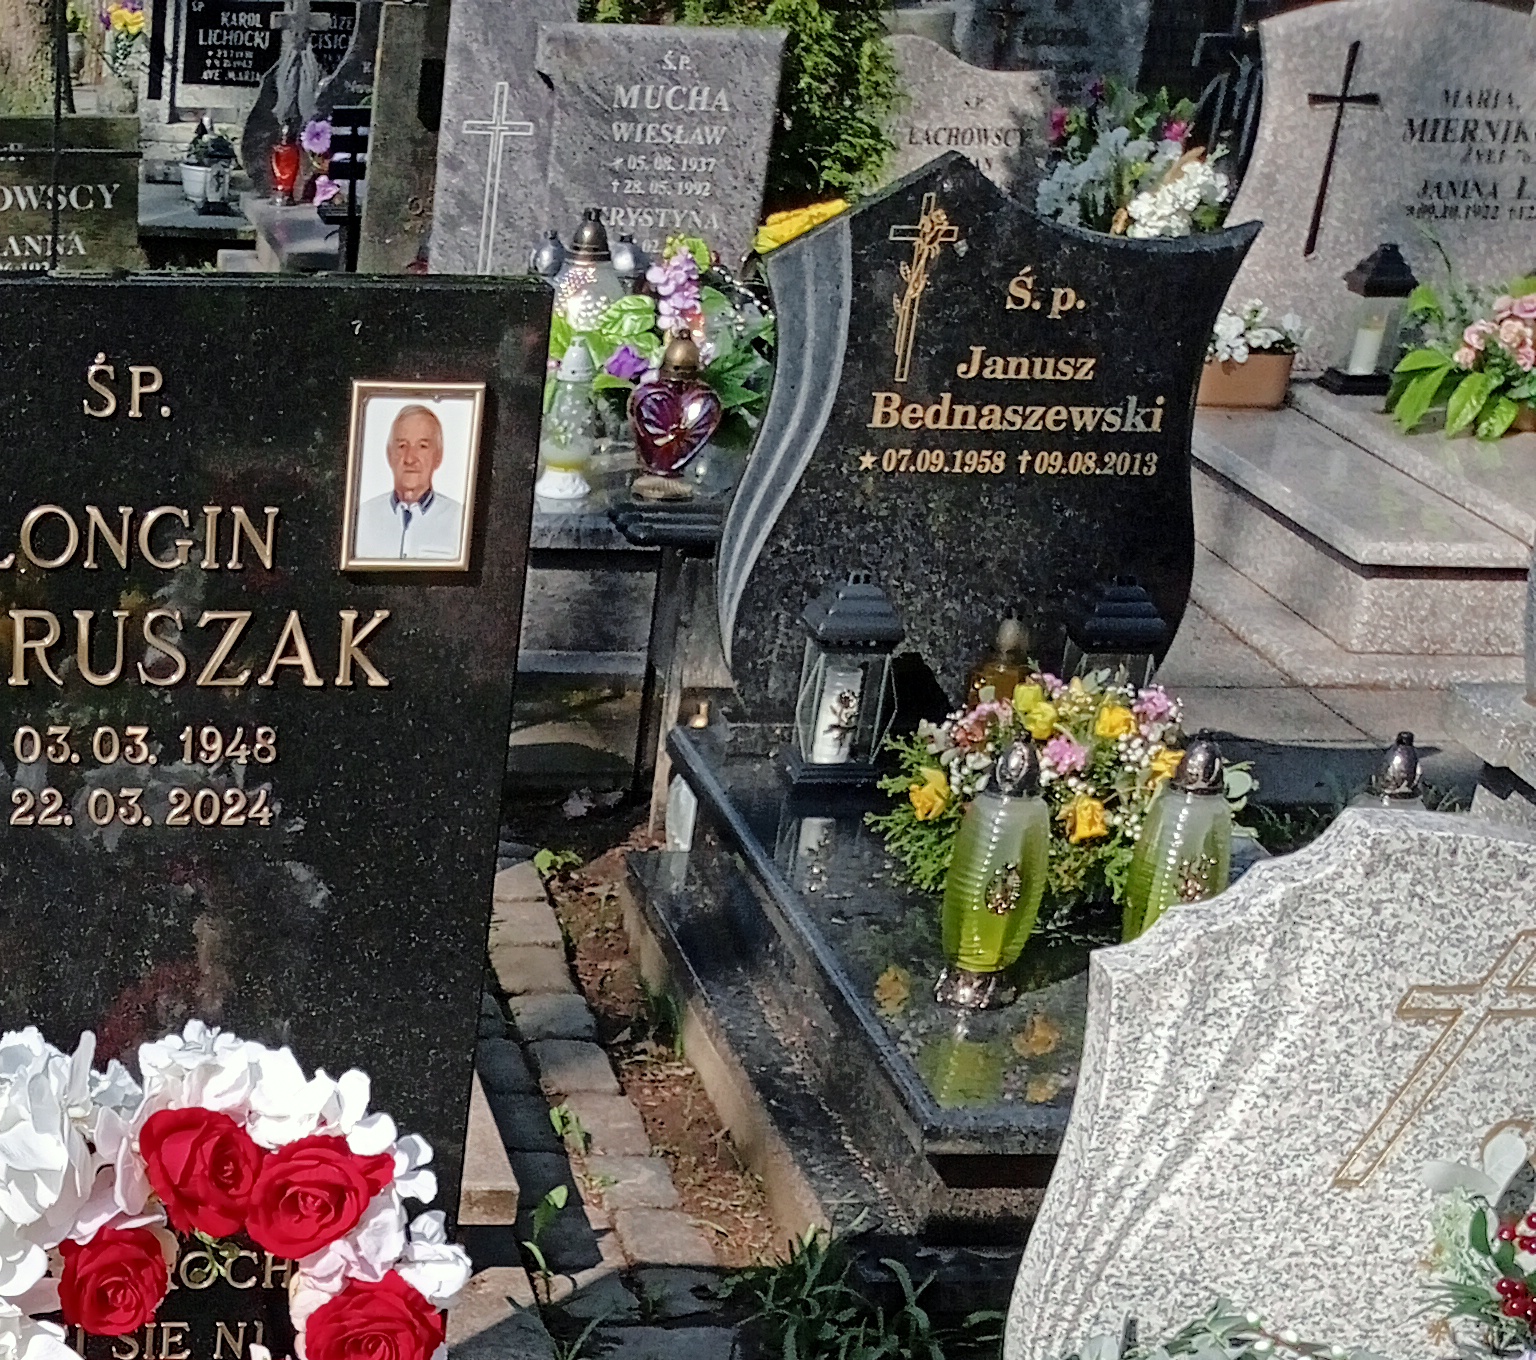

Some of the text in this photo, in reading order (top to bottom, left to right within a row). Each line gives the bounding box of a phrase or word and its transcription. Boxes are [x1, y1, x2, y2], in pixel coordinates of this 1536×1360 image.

[198, 29, 270, 50] LICHOCKI
[613, 84, 730, 111] MUCHA
[612, 122, 728, 145] WIESŁAW
[956, 345, 1098, 381] Janusz
[866, 391, 1166, 433] Bednaszewski
[881, 449, 1159, 476] 07.09.1958 09.08.2013
[178, 726, 278, 764] 1948
[165, 787, 272, 826] 2024
